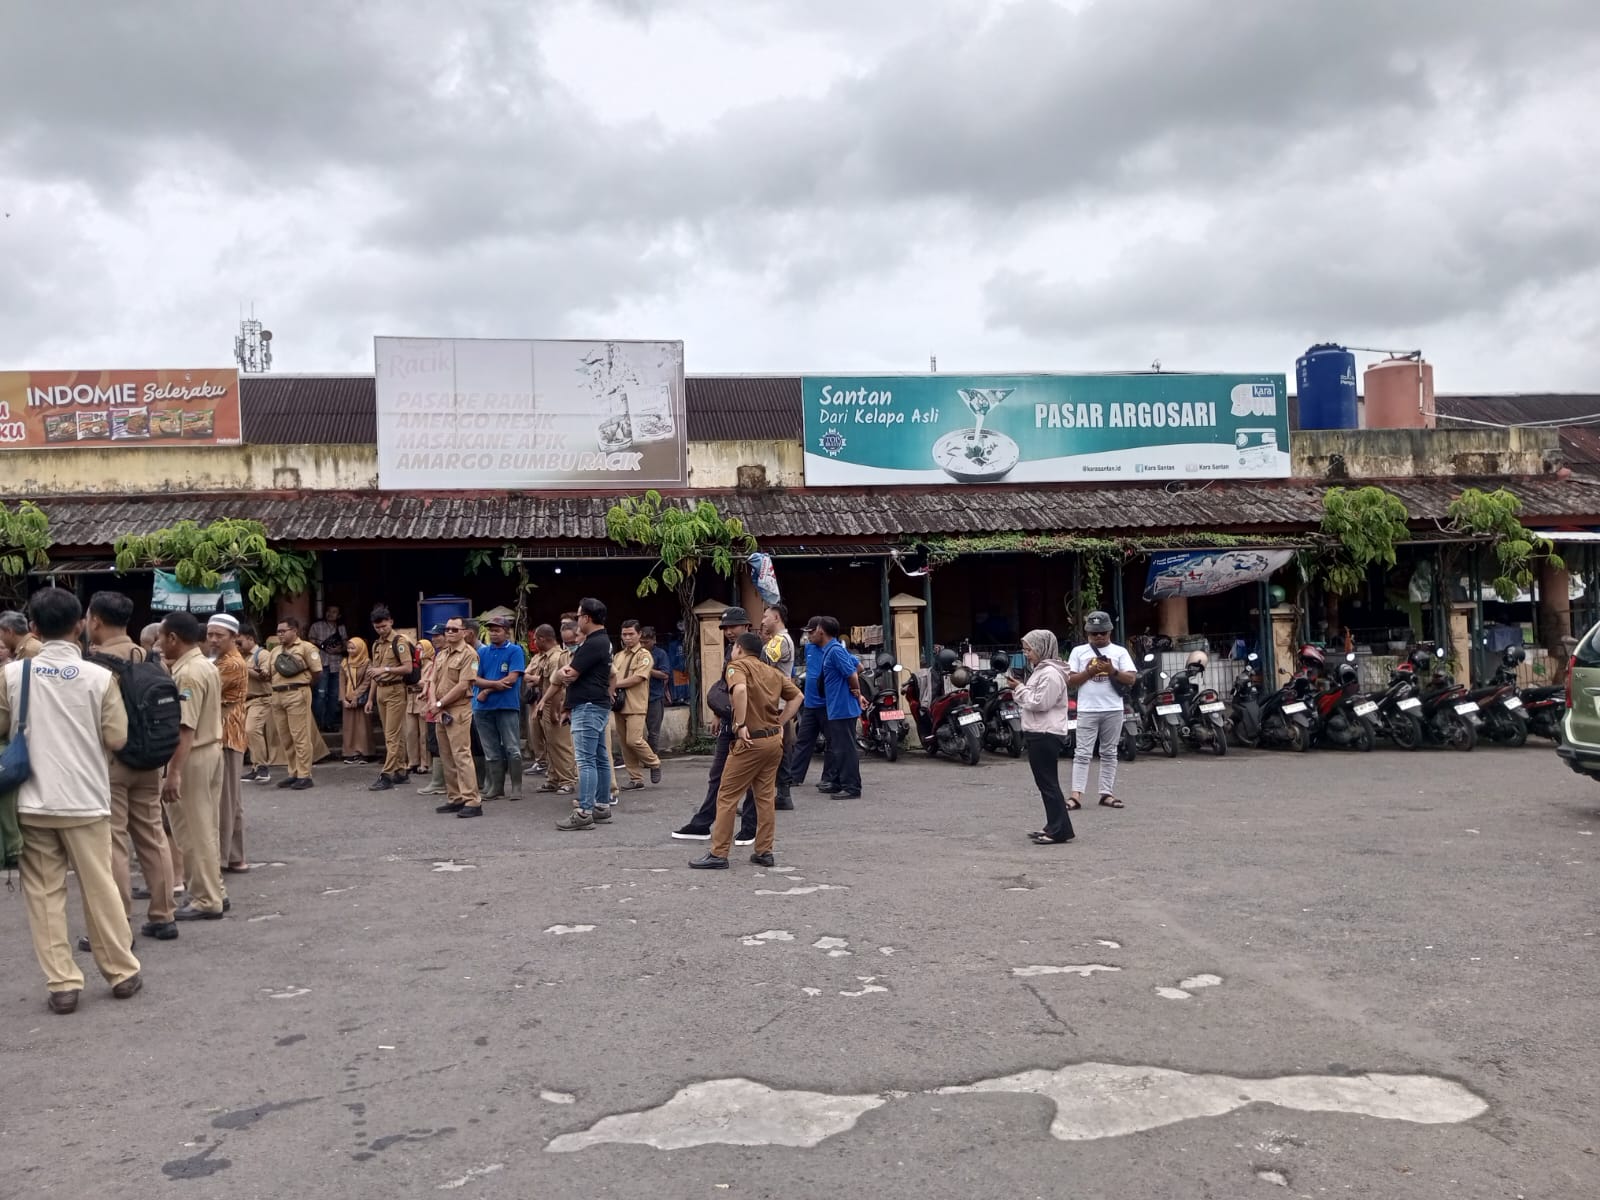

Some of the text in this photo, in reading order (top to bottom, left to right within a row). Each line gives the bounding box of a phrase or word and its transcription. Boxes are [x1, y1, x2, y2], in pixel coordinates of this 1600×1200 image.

[389, 352, 451, 378] Racik
[27, 381, 226, 406] INDOMIE Seleraku
[396, 393, 544, 409] PASARE RAME
[819, 385, 892, 406] Santan
[1253, 386, 1273, 397] kara
[396, 413, 558, 429] AMERGO RESIK
[819, 408, 939, 428] Dari Kelapa Asli
[1035, 402, 1216, 428] PASAR ARGOSARI
[396, 432, 568, 449] MASAKANE APIK
[396, 452, 642, 471] AMARGO BUMBU RACIK
[36, 667, 60, 676] P2KP
